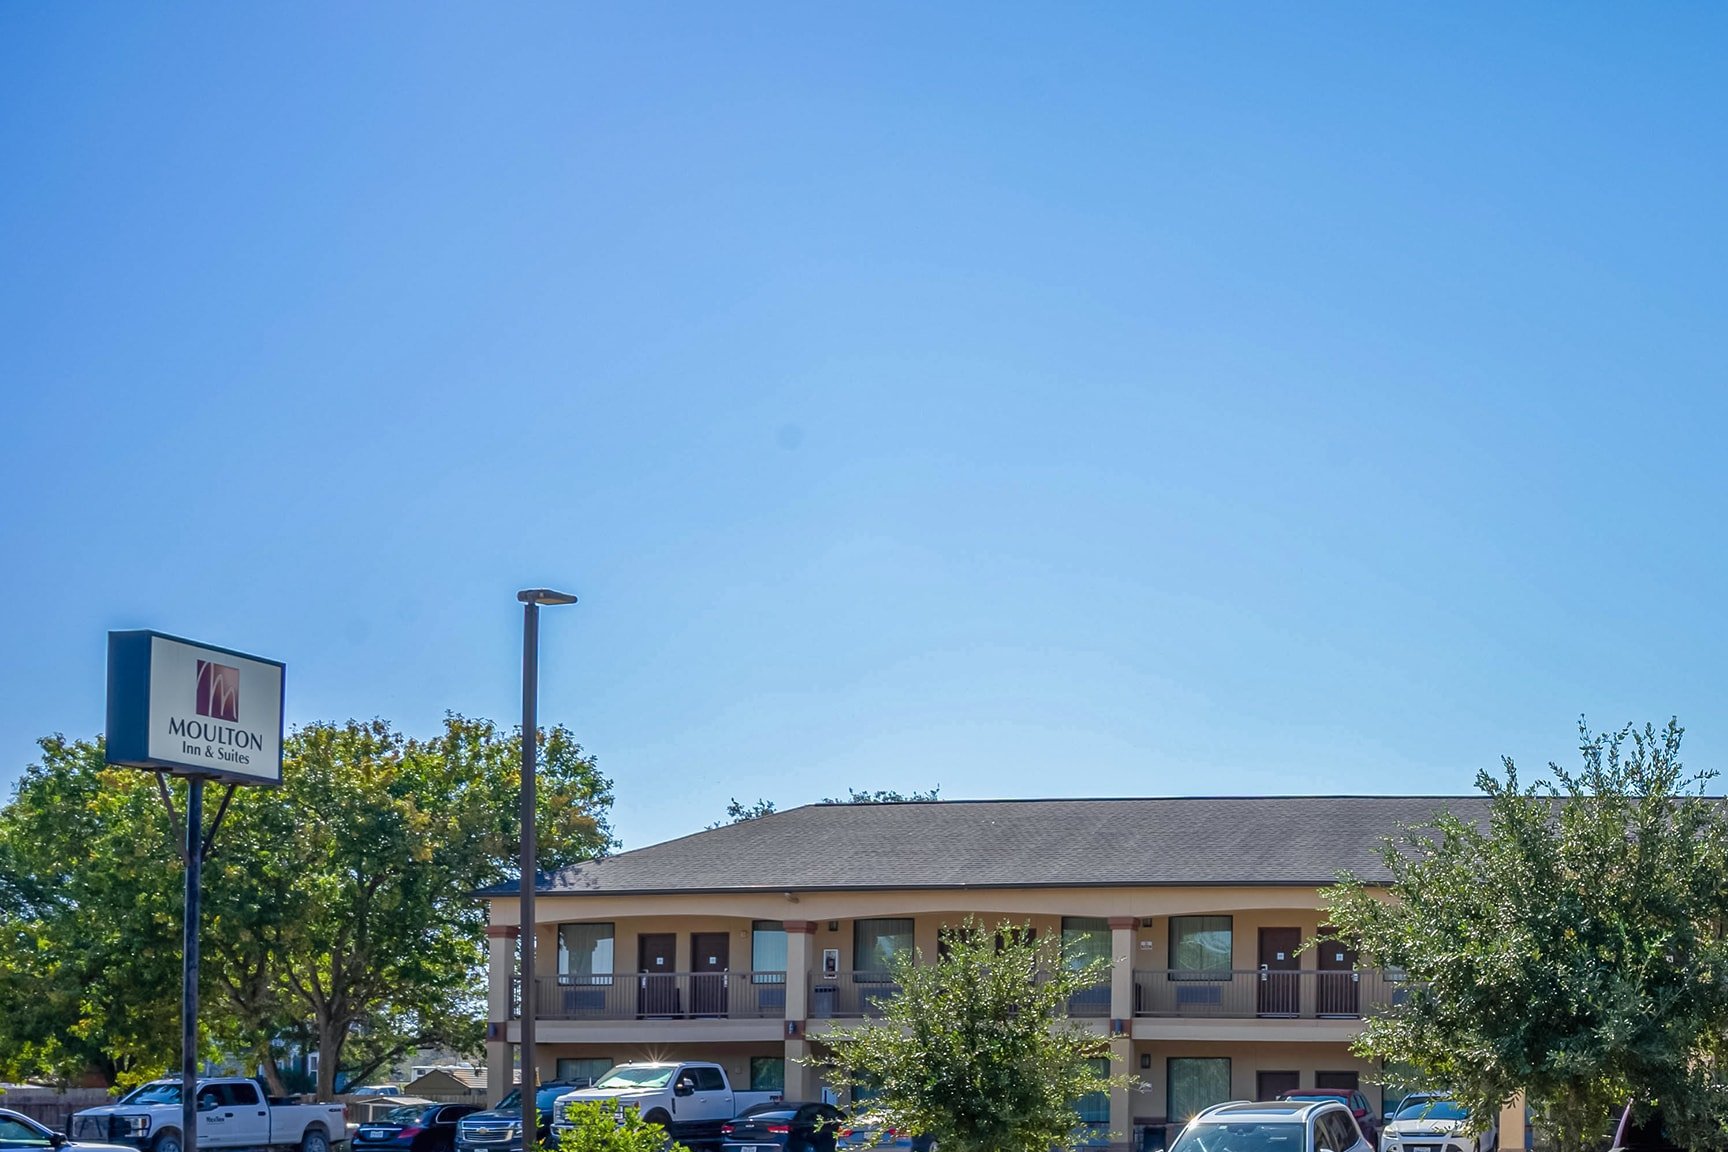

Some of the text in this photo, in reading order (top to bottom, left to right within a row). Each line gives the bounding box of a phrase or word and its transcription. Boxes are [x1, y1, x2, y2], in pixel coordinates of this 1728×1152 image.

[168, 716, 263, 751] MOULTON
[182, 740, 250, 765] Inn & Suites
